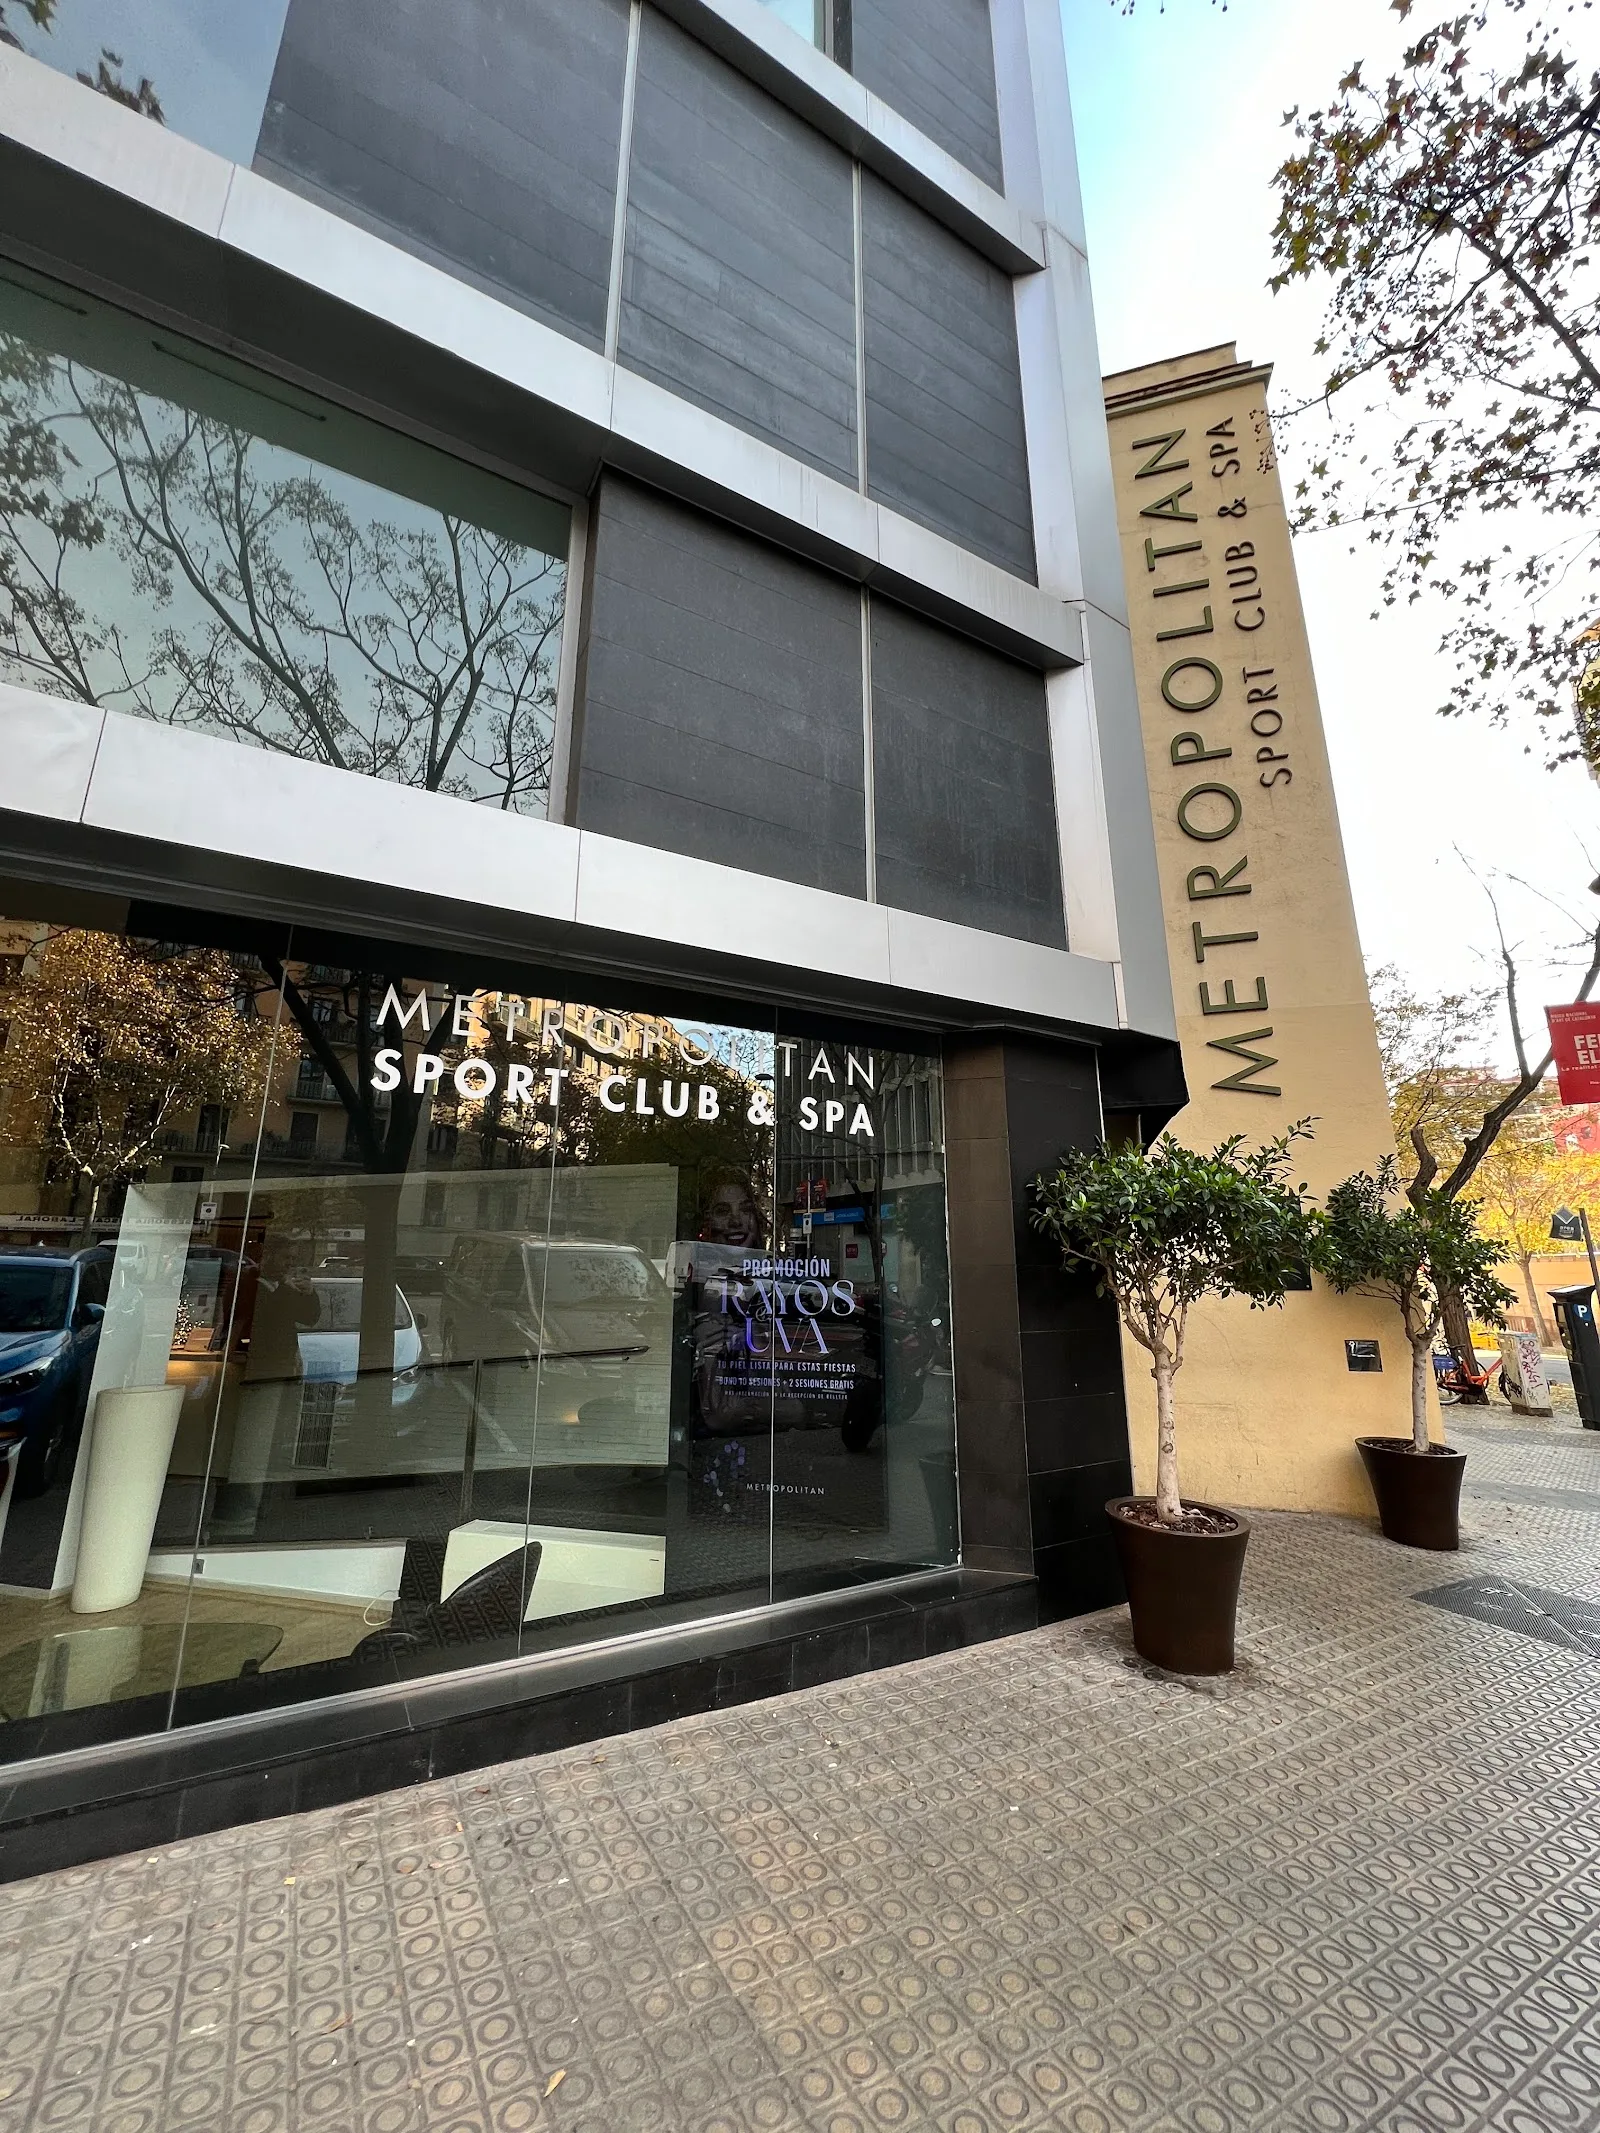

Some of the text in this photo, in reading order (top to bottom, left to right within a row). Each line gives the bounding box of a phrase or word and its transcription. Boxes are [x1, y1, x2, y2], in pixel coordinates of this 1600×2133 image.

[1206, 416, 1293, 788] SPORT CLUB & SPA
[1131, 428, 1282, 1096] METROPOLITAN
[375, 982, 875, 1090] METROPOLITAN
[1574, 1033, 1600, 1050] FE
[370, 1048, 875, 1137] SPORT CLUB & SPA
[742, 1255, 830, 1278] PROMOCIÓN
[720, 1279, 856, 1316] RAYOS
[1577, 1304, 1588, 1318] P
[745, 1317, 830, 1354] UVA
[729, 1360, 747, 1370] PIEL
[750, 1361, 771, 1370] LISTA
[774, 1361, 794, 1371] PARA
[797, 1362, 821, 1372] ESTAS
[823, 1362, 856, 1373] FIESTAS
[748, 1377, 781, 1387] SESIONES
[788, 1378, 794, 1388] 2
[795, 1378, 828, 1389] SESIONES
[829, 1379, 855, 1390] GRATIS
[745, 1483, 825, 1495] METROPOLITAN
